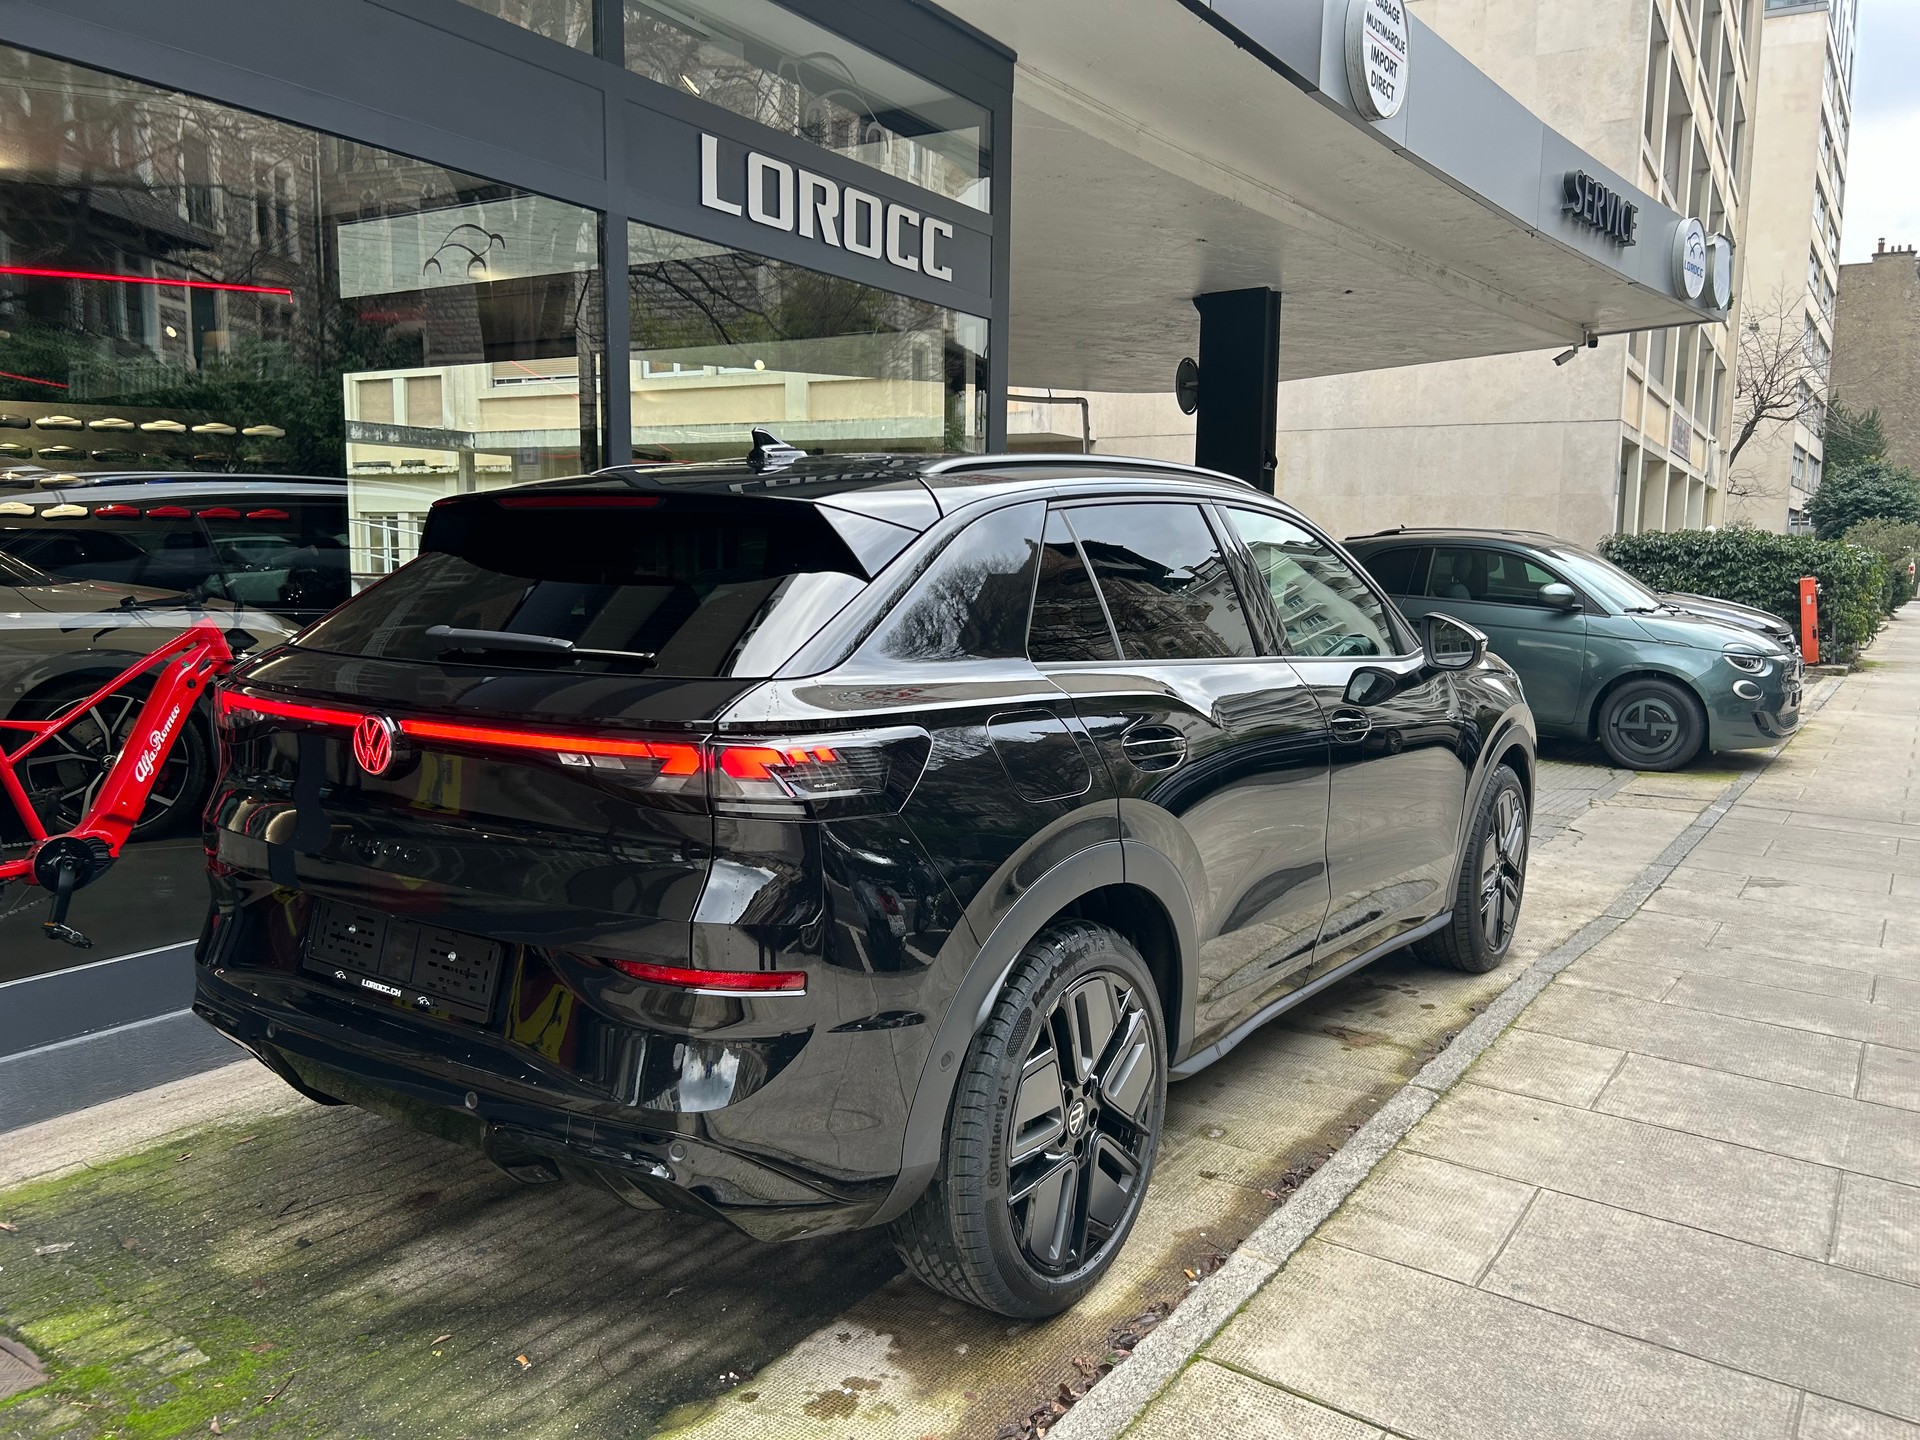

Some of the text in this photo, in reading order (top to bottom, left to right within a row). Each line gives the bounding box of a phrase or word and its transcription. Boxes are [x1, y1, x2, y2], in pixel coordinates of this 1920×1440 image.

[1366, 11, 1406, 55] MULTIMARQUE
[1370, 44, 1398, 79] IMPORT
[1370, 70, 1395, 102] DIRECT
[701, 132, 954, 283] LOROCC
[1563, 169, 1639, 247] SERVICE
[1683, 259, 1704, 279] LOROCC
[135, 703, 181, 783] Alfa Romeo
[361, 978, 402, 998] LOROCC.CH
[987, 1087, 1010, 1189] Continental
